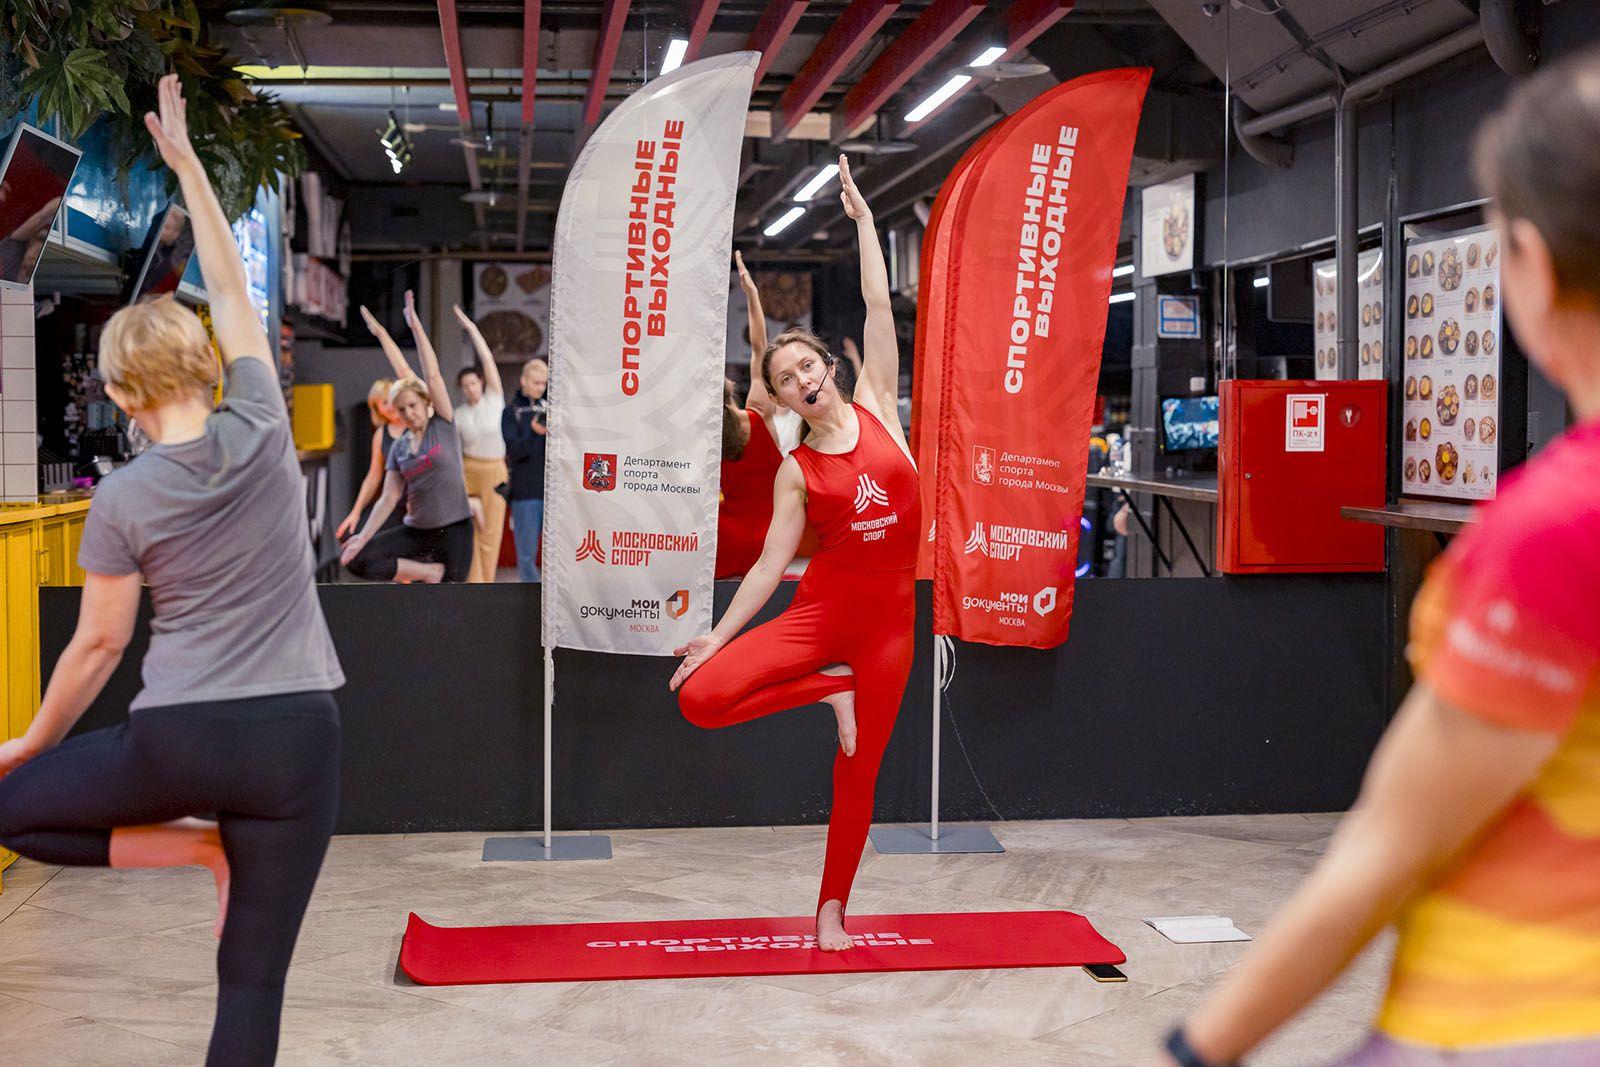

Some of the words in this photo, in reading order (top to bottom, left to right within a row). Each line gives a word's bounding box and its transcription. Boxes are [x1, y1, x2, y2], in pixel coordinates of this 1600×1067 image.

[647, 119, 685, 337] ВЫХОДНЫЕ
[1035, 125, 1079, 338] ВЫХОДНЫЕ
[621, 139, 656, 397] СПОРТИВНЫЕ
[1004, 143, 1052, 394] СПОРТИВНЫЕ
[624, 455, 691, 470] Департамент
[1000, 451, 1060, 468] Департамент
[624, 469, 658, 480] спорта
[1000, 465, 1034, 477] спорта
[623, 481, 659, 493] города
[660, 483, 700, 494] Москвы
[999, 478, 1033, 490] города
[1035, 480, 1069, 494] Москвы
[851, 512, 898, 531] МОСКОВСКИЙ
[612, 531, 699, 552] МОСКОВСКИЙ
[863, 529, 886, 542] СПОРТ
[990, 524, 1068, 550] МОСКОВСКИЙ
[611, 550, 652, 567] СПОРТ
[990, 542, 1023, 561] СПОРТ
[580, 605, 660, 620] документы
[962, 596, 1028, 614] документы
[629, 624, 660, 633] МОСКВА
[999, 617, 1025, 627] МОСКВА
